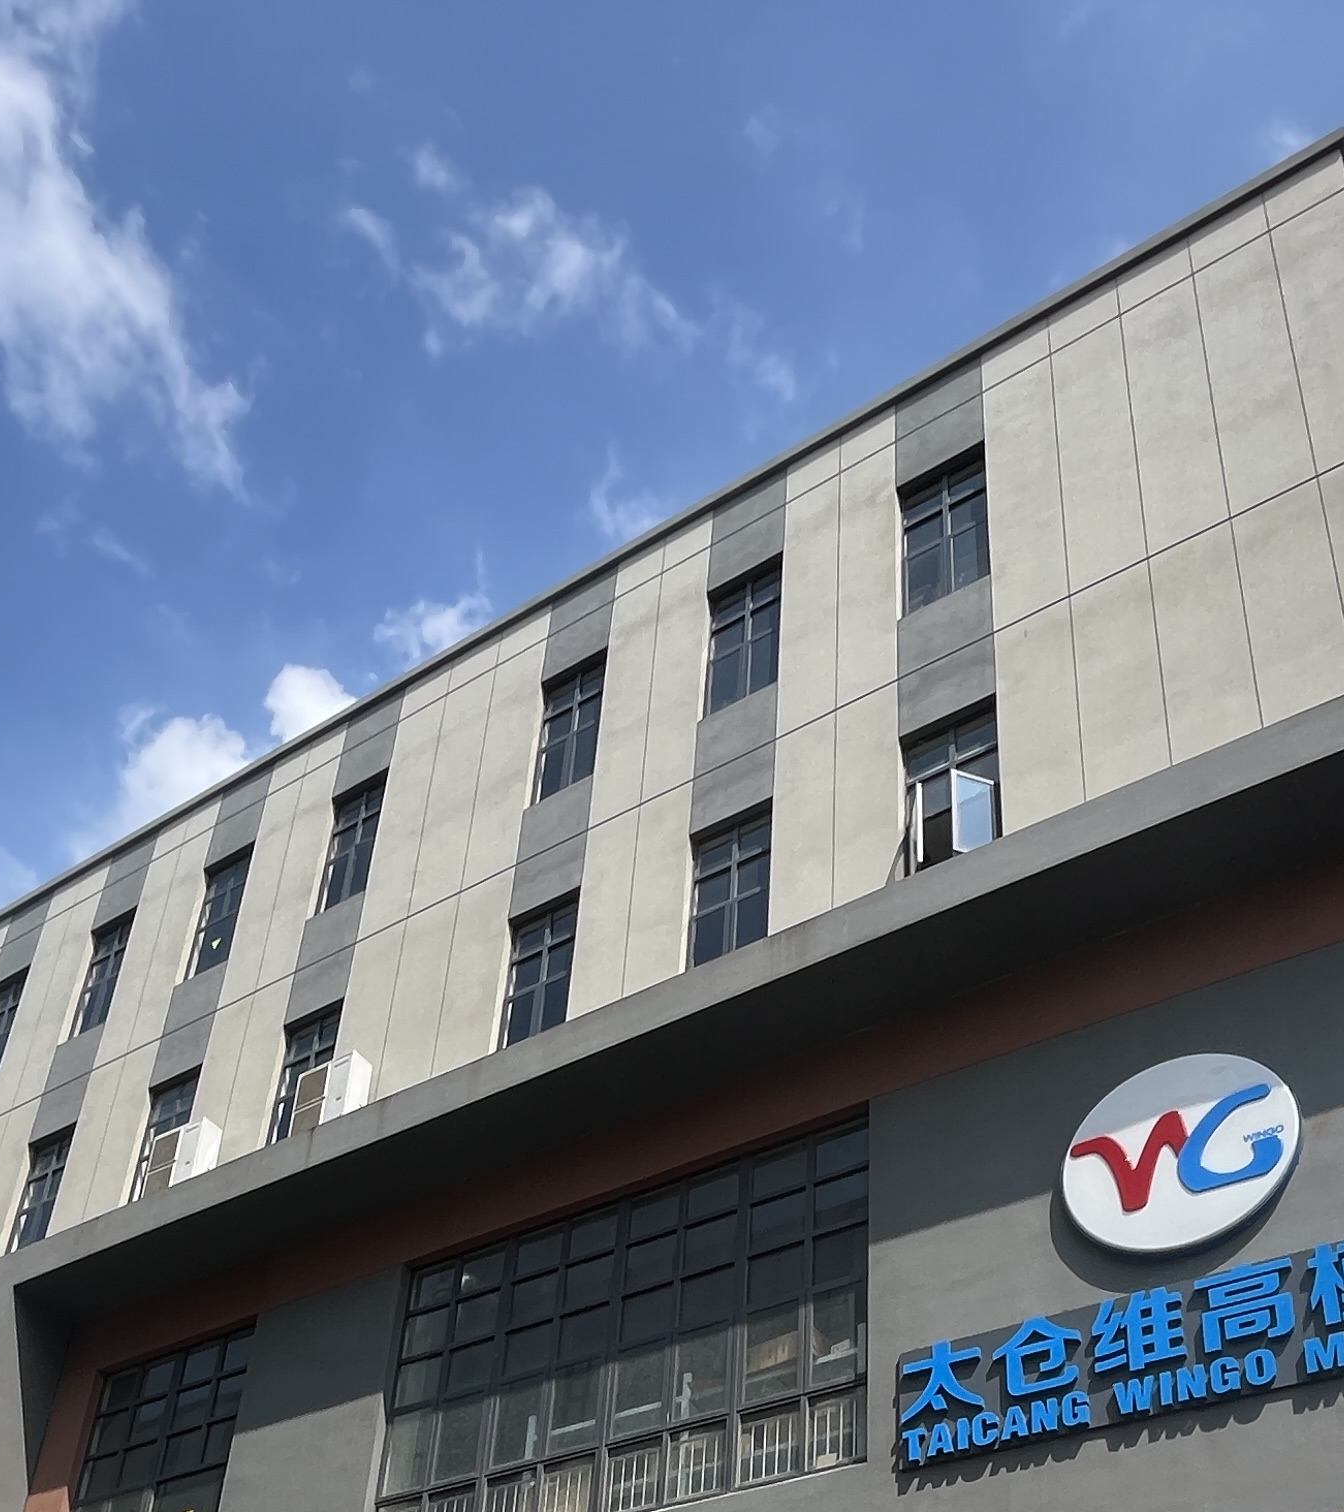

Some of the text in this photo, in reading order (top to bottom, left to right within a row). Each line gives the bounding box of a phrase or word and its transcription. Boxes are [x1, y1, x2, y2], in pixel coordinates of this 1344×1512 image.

[1242, 1124, 1285, 1143] WINGO
[902, 1390, 1091, 1463] TAICANG
[1113, 1347, 1276, 1416] WINGO
